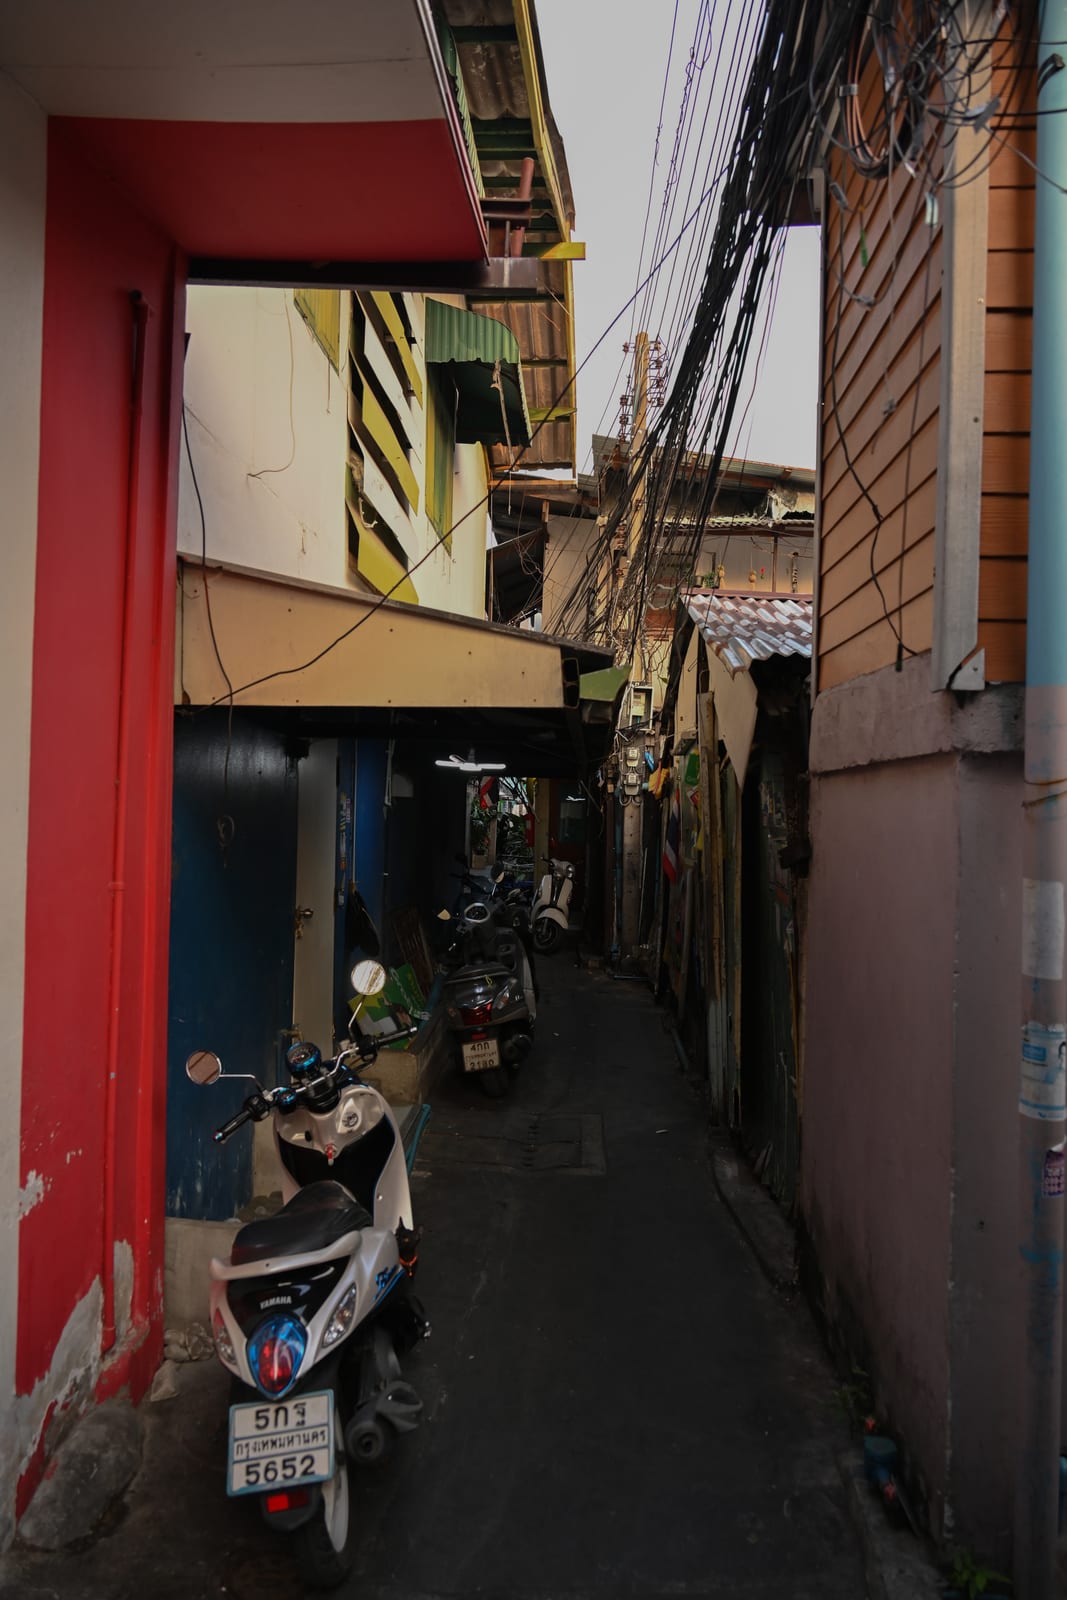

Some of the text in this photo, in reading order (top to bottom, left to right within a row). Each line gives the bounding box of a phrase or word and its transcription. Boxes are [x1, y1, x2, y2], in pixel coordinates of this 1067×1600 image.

[259, 1295, 293, 1310] YAMAHA
[235, 1430, 326, 1459] กรุงเทพมหานคร
[246, 1454, 315, 1485] 5652
